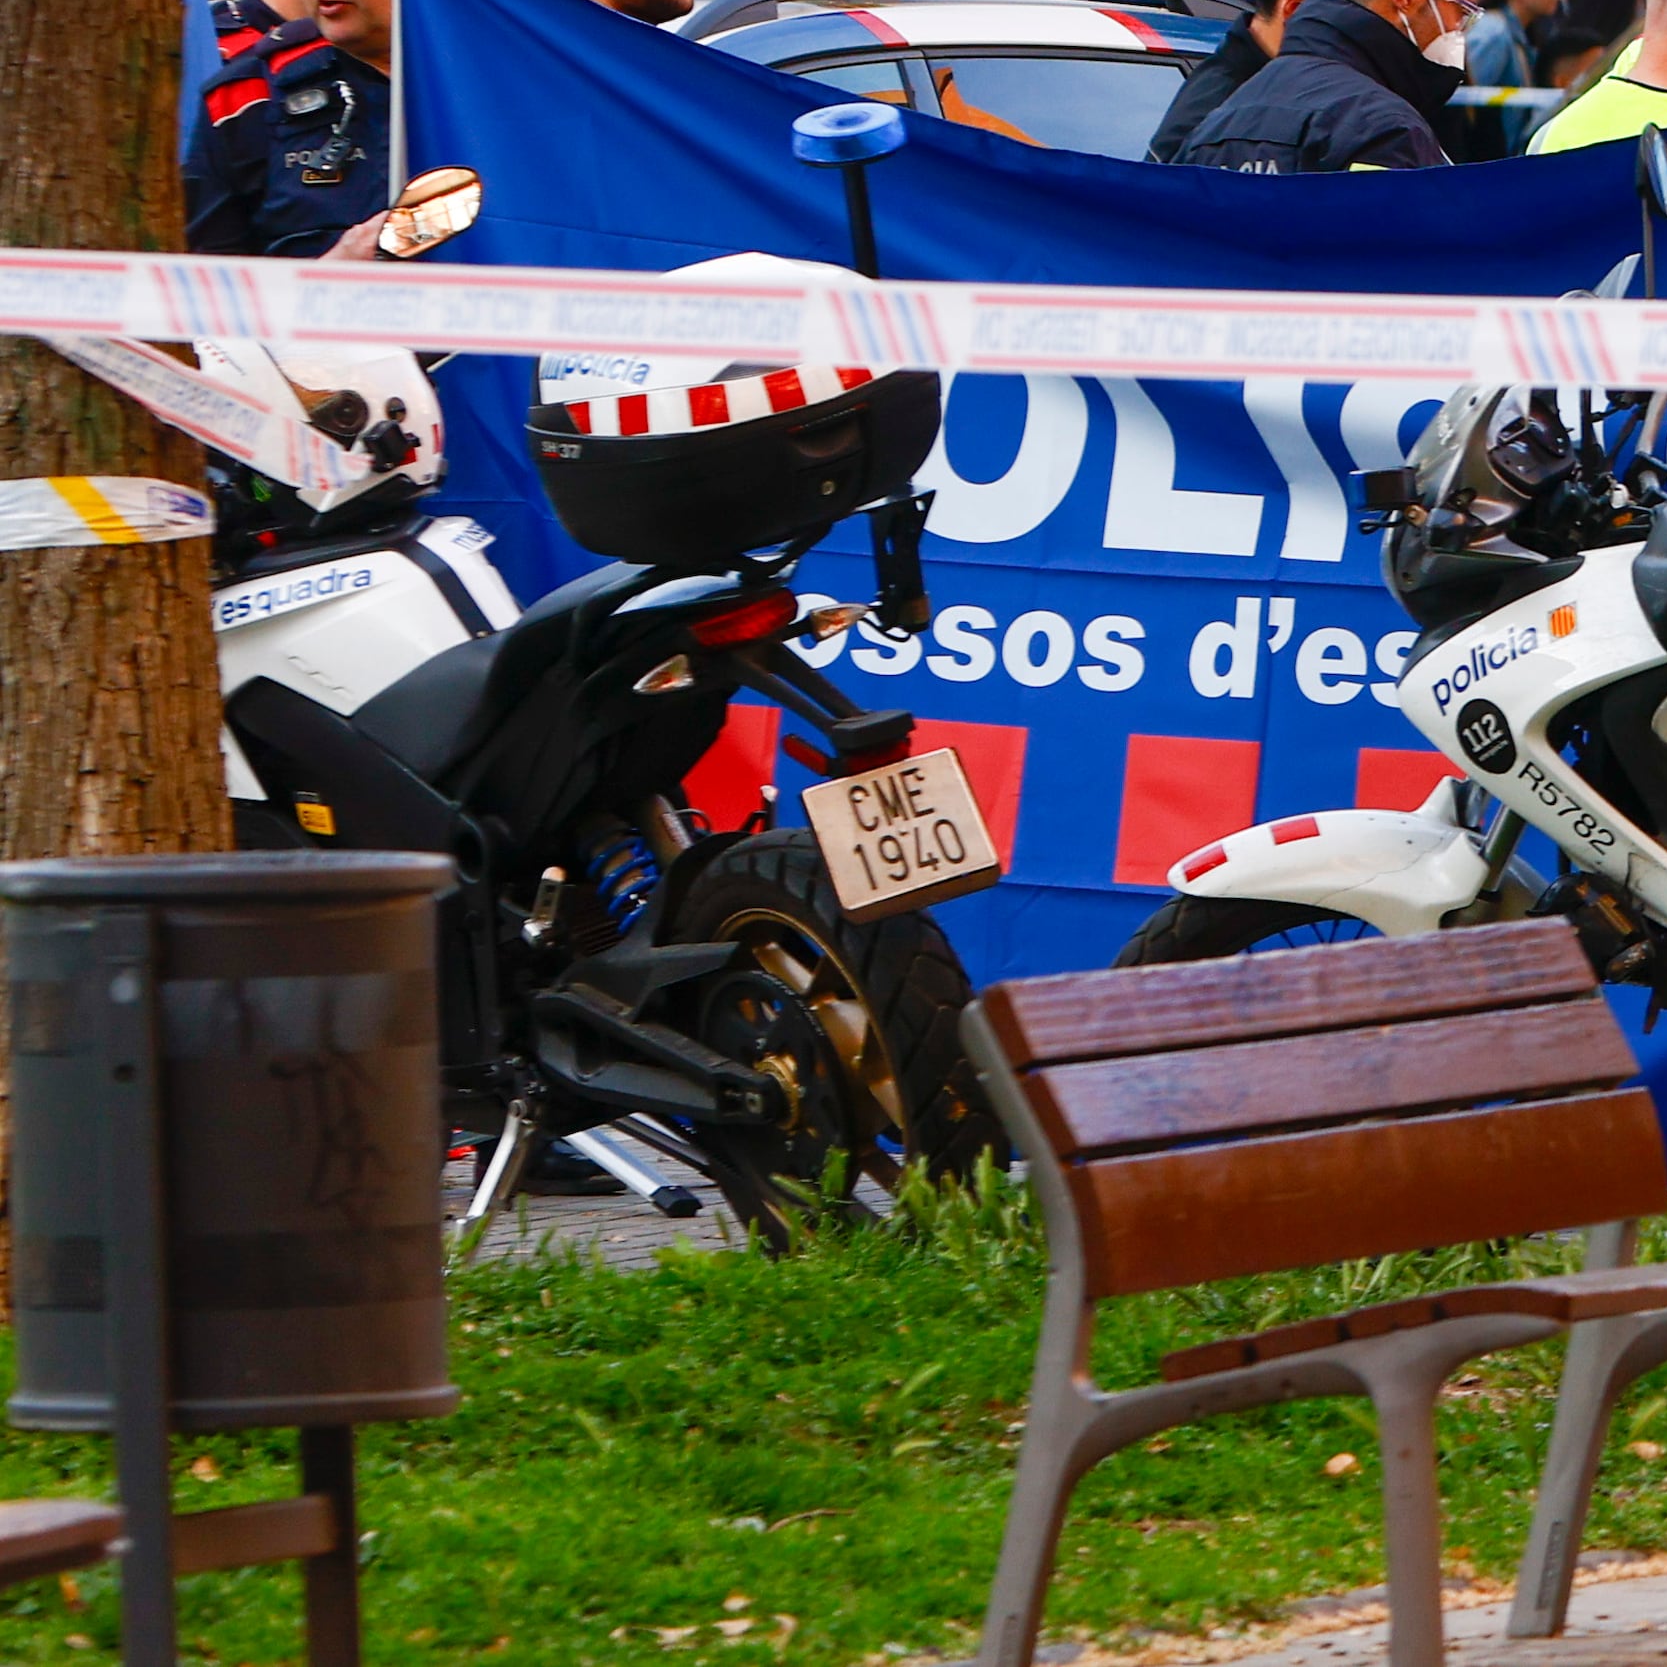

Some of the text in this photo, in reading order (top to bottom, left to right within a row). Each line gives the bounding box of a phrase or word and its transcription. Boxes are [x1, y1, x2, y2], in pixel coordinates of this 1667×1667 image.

[785, 591, 1147, 693] ossos
[1431, 626, 1539, 716] policia
[1462, 712, 1504, 753] 112
[849, 766, 935, 832] CME
[1518, 760, 1616, 857] R5782
[852, 818, 967, 891] 1940
